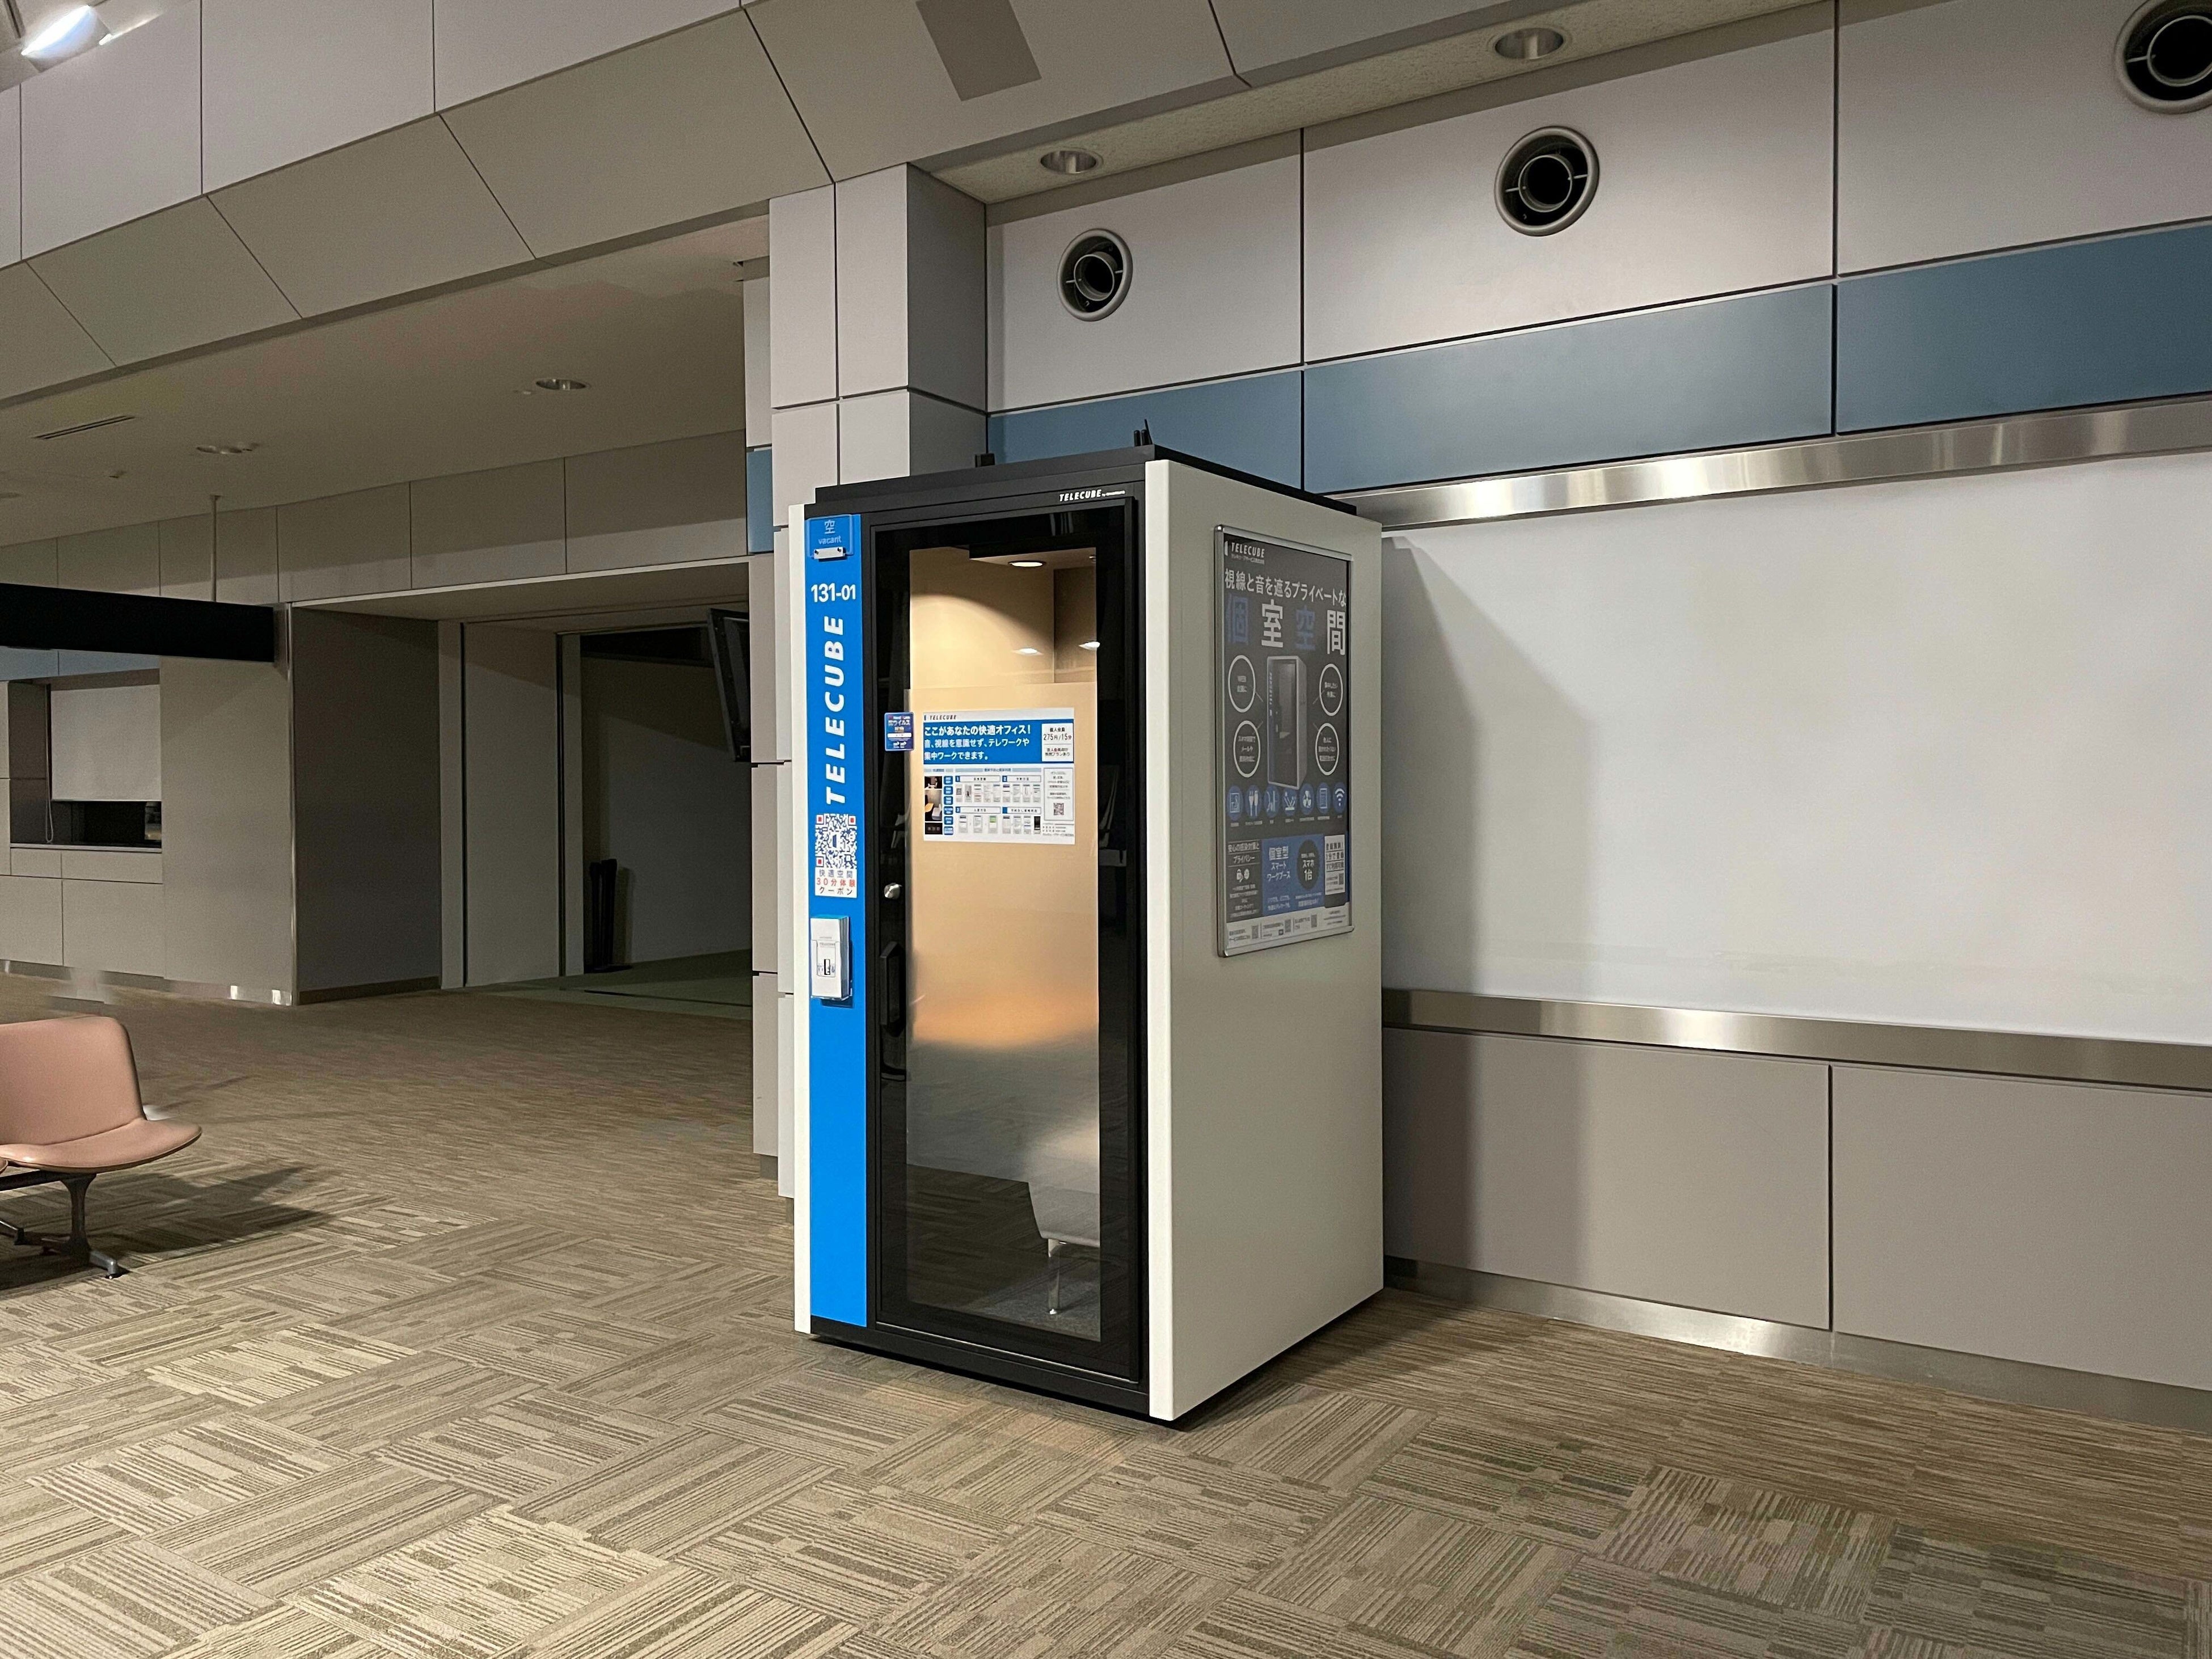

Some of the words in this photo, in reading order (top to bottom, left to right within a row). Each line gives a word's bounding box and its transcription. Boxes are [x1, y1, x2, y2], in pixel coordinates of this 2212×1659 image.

[1059, 489, 1101, 501] TELECUBE
[824, 520, 835, 534] 空
[818, 535, 842, 544] vacant
[1231, 542, 1265, 558] TELECUBE
[811, 583, 856, 602] 131-01
[1225, 568, 1346, 607] 視線と音を遮るプライベートな
[824, 616, 845, 804] TELECUBE
